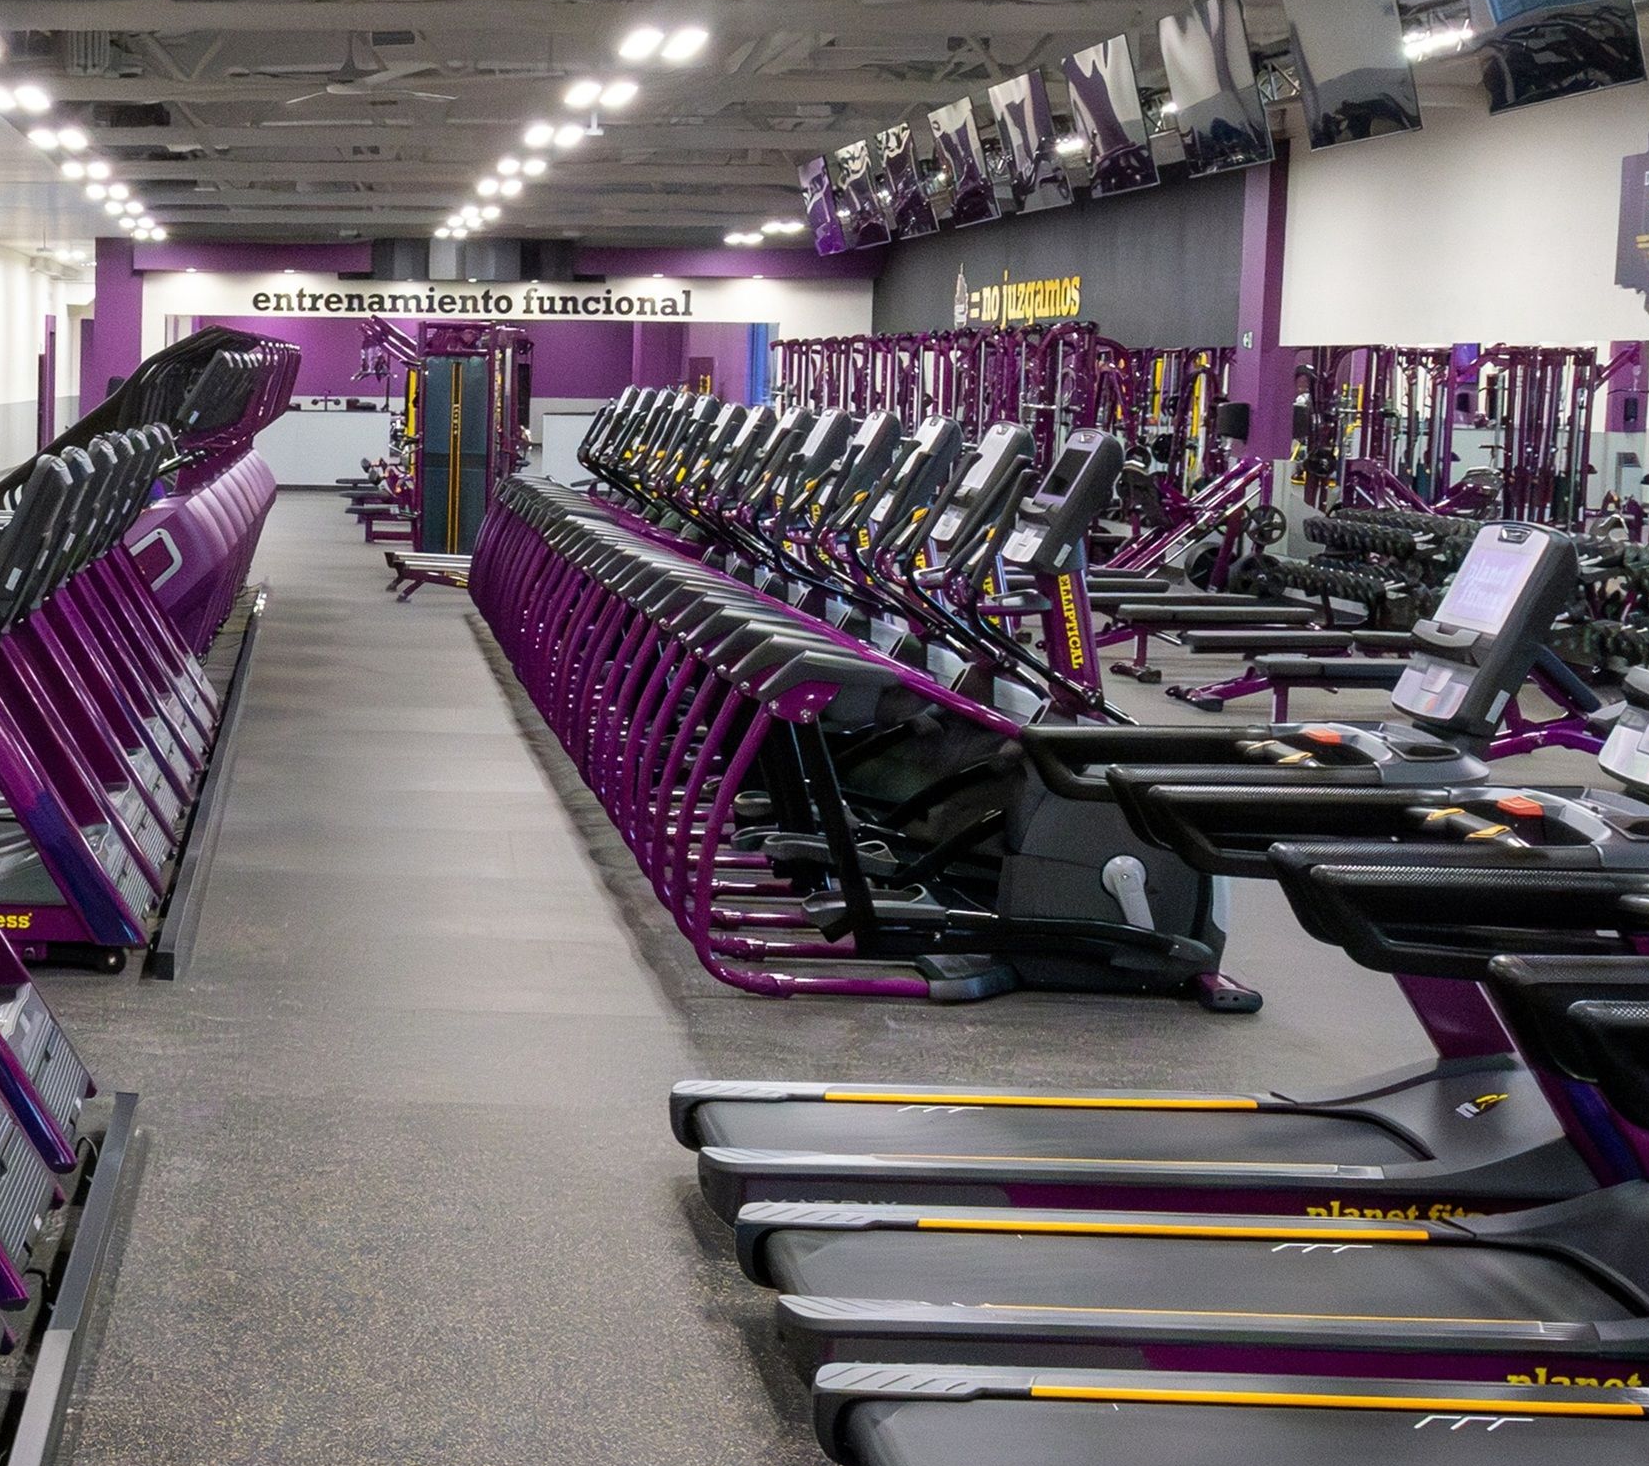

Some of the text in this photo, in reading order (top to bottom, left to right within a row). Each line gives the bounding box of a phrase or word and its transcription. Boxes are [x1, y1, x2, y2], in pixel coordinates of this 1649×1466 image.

[252, 286, 693, 317] entrenamiento funcional
[981, 284, 1000, 321] no
[1000, 269, 1081, 330] juzgamos
[1058, 574, 1084, 670] ELLIPTICAL
